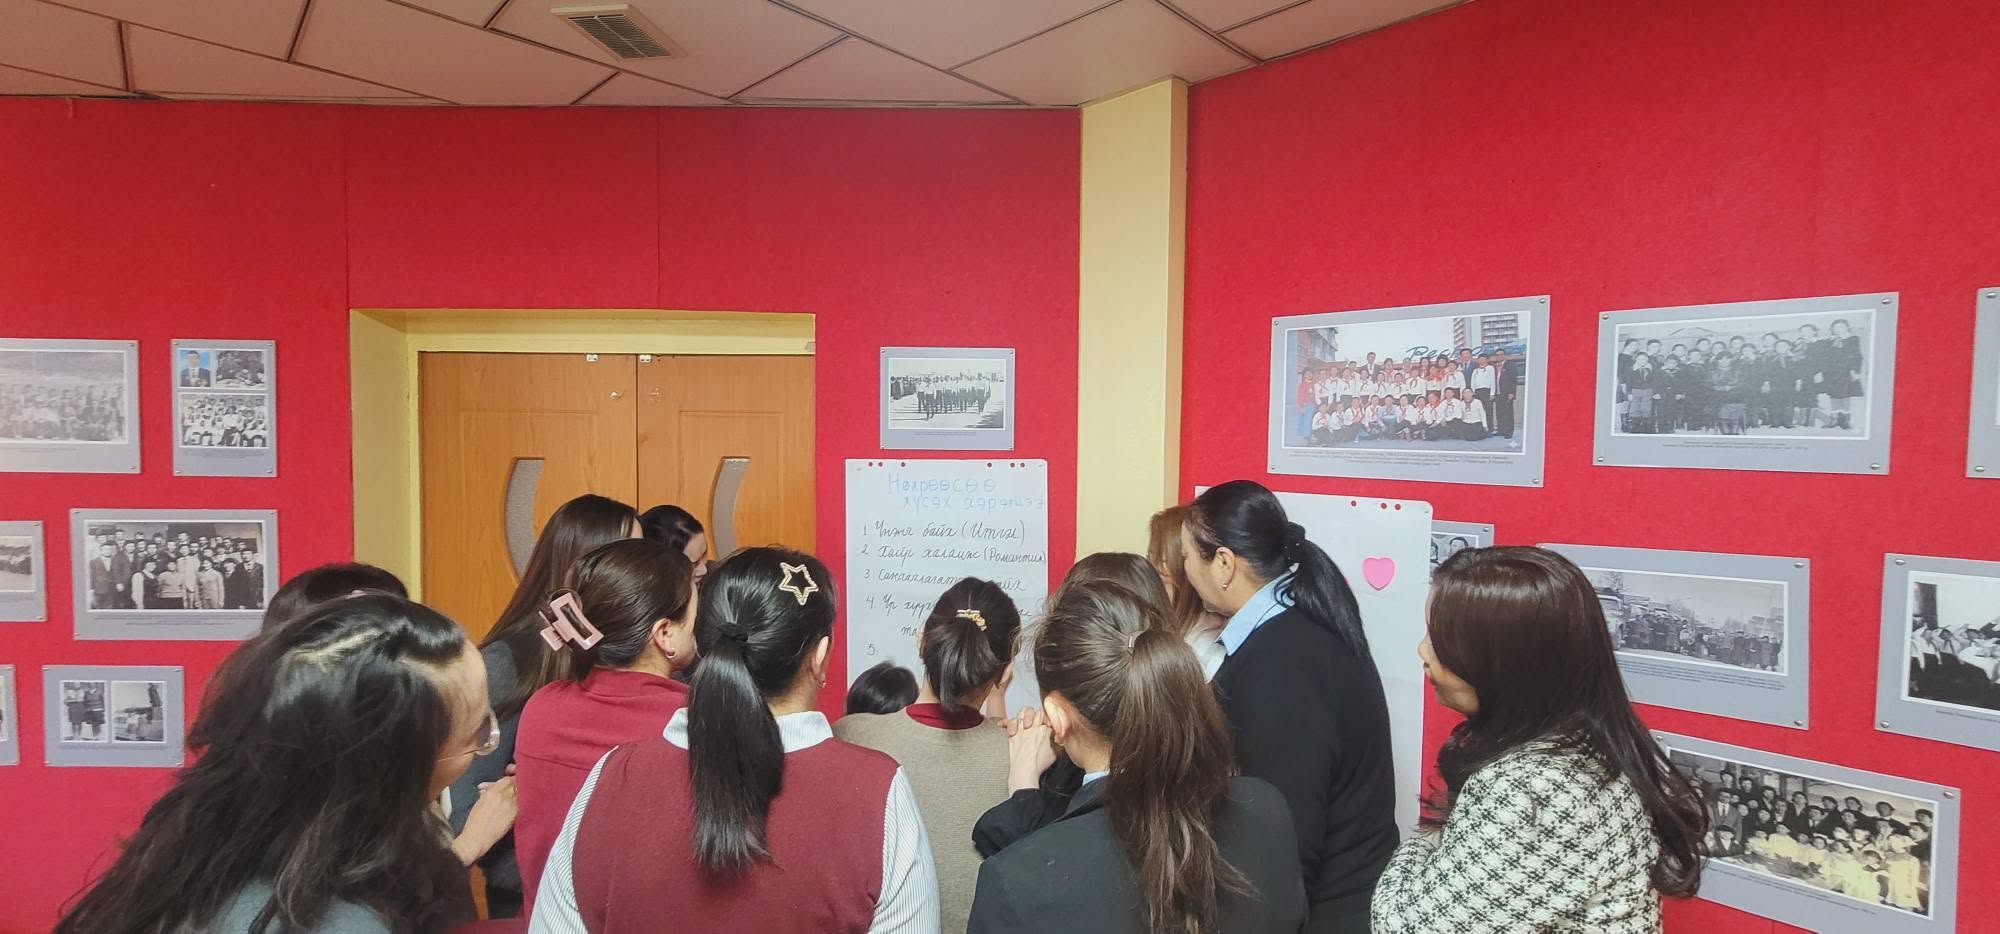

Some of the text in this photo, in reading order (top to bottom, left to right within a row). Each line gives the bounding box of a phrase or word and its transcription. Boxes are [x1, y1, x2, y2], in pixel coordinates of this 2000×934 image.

[921, 522, 959, 538] байх
[878, 545, 915, 567] Хайр
[863, 568, 871, 580] 3
